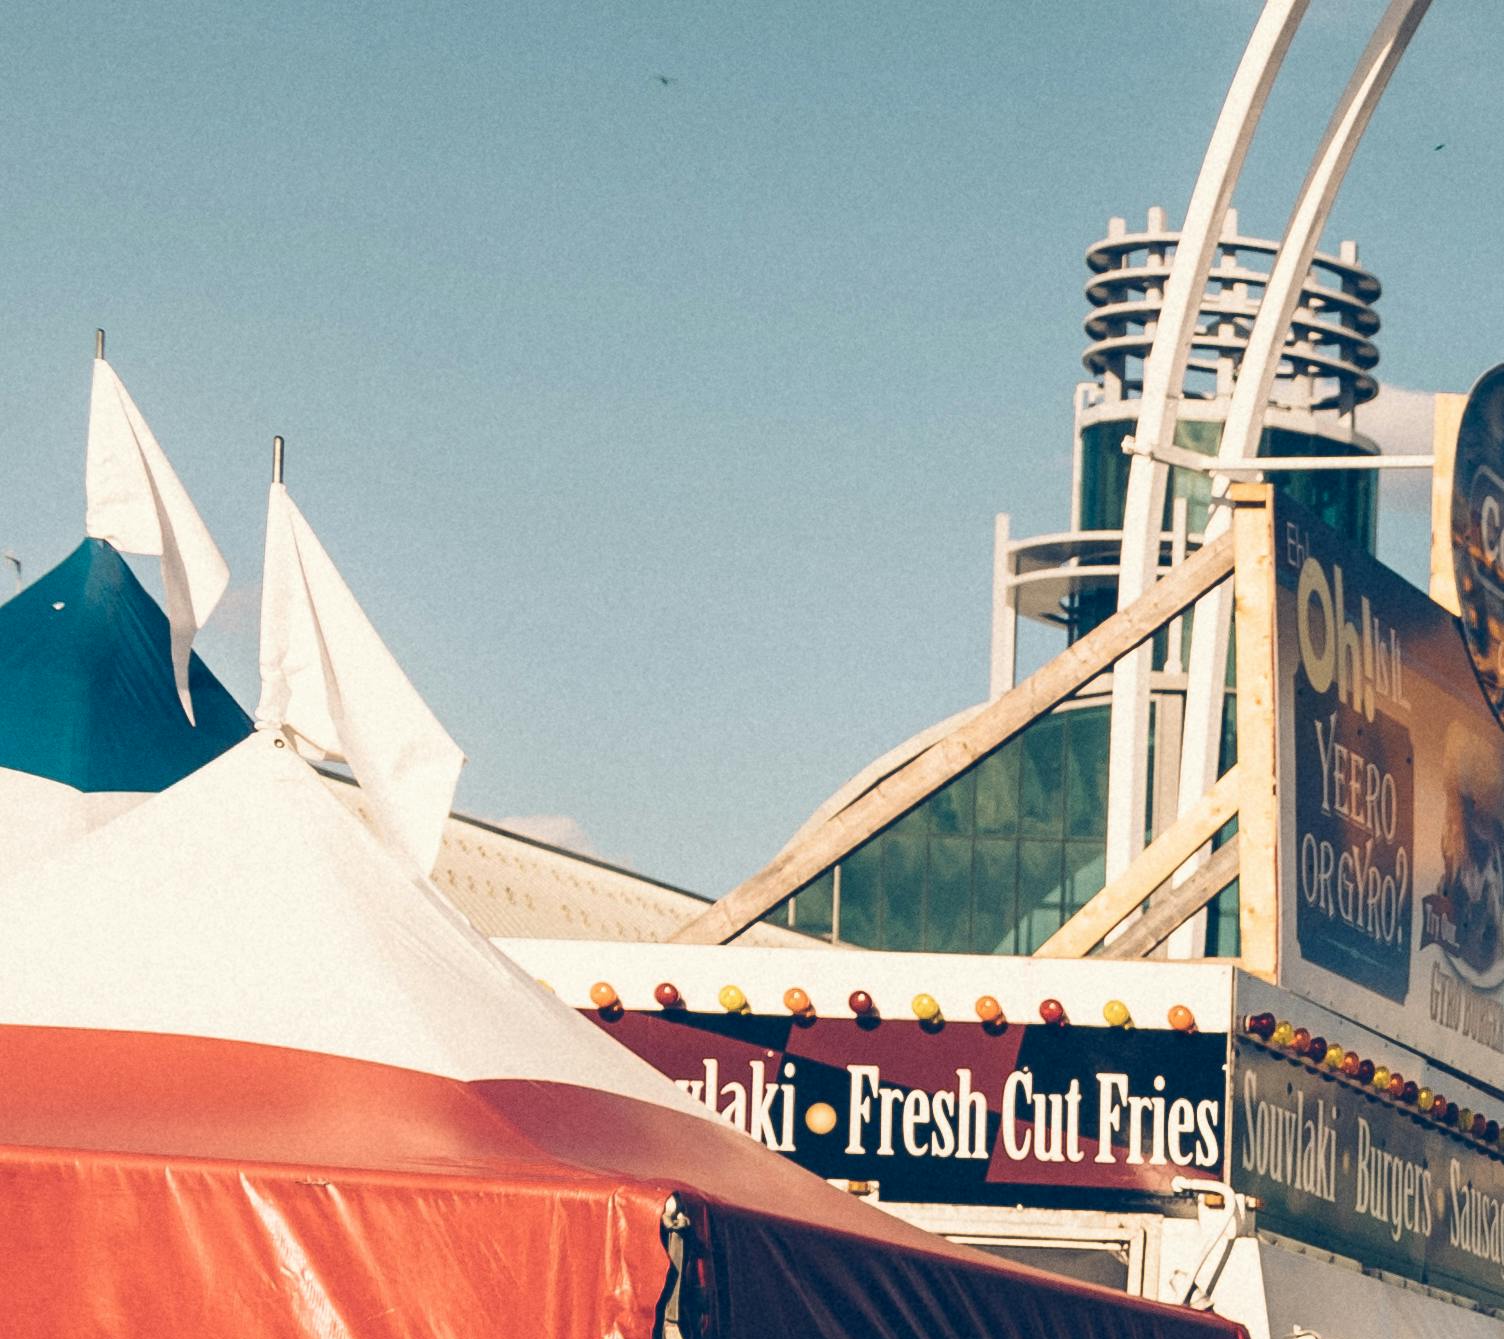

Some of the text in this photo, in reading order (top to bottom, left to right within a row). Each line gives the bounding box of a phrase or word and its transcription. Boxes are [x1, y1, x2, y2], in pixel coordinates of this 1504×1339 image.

[1297, 557, 1375, 724] Oh!
[1315, 710, 1397, 844] YEERO
[1302, 833, 1334, 919] OR
[845, 1064, 989, 1160] Fresh
[1002, 1068, 1084, 1163] Cut
[1095, 1073, 1219, 1167] Fries
[1242, 1069, 1337, 1202] Souvlaki
[1356, 1116, 1433, 1242] Burgers
